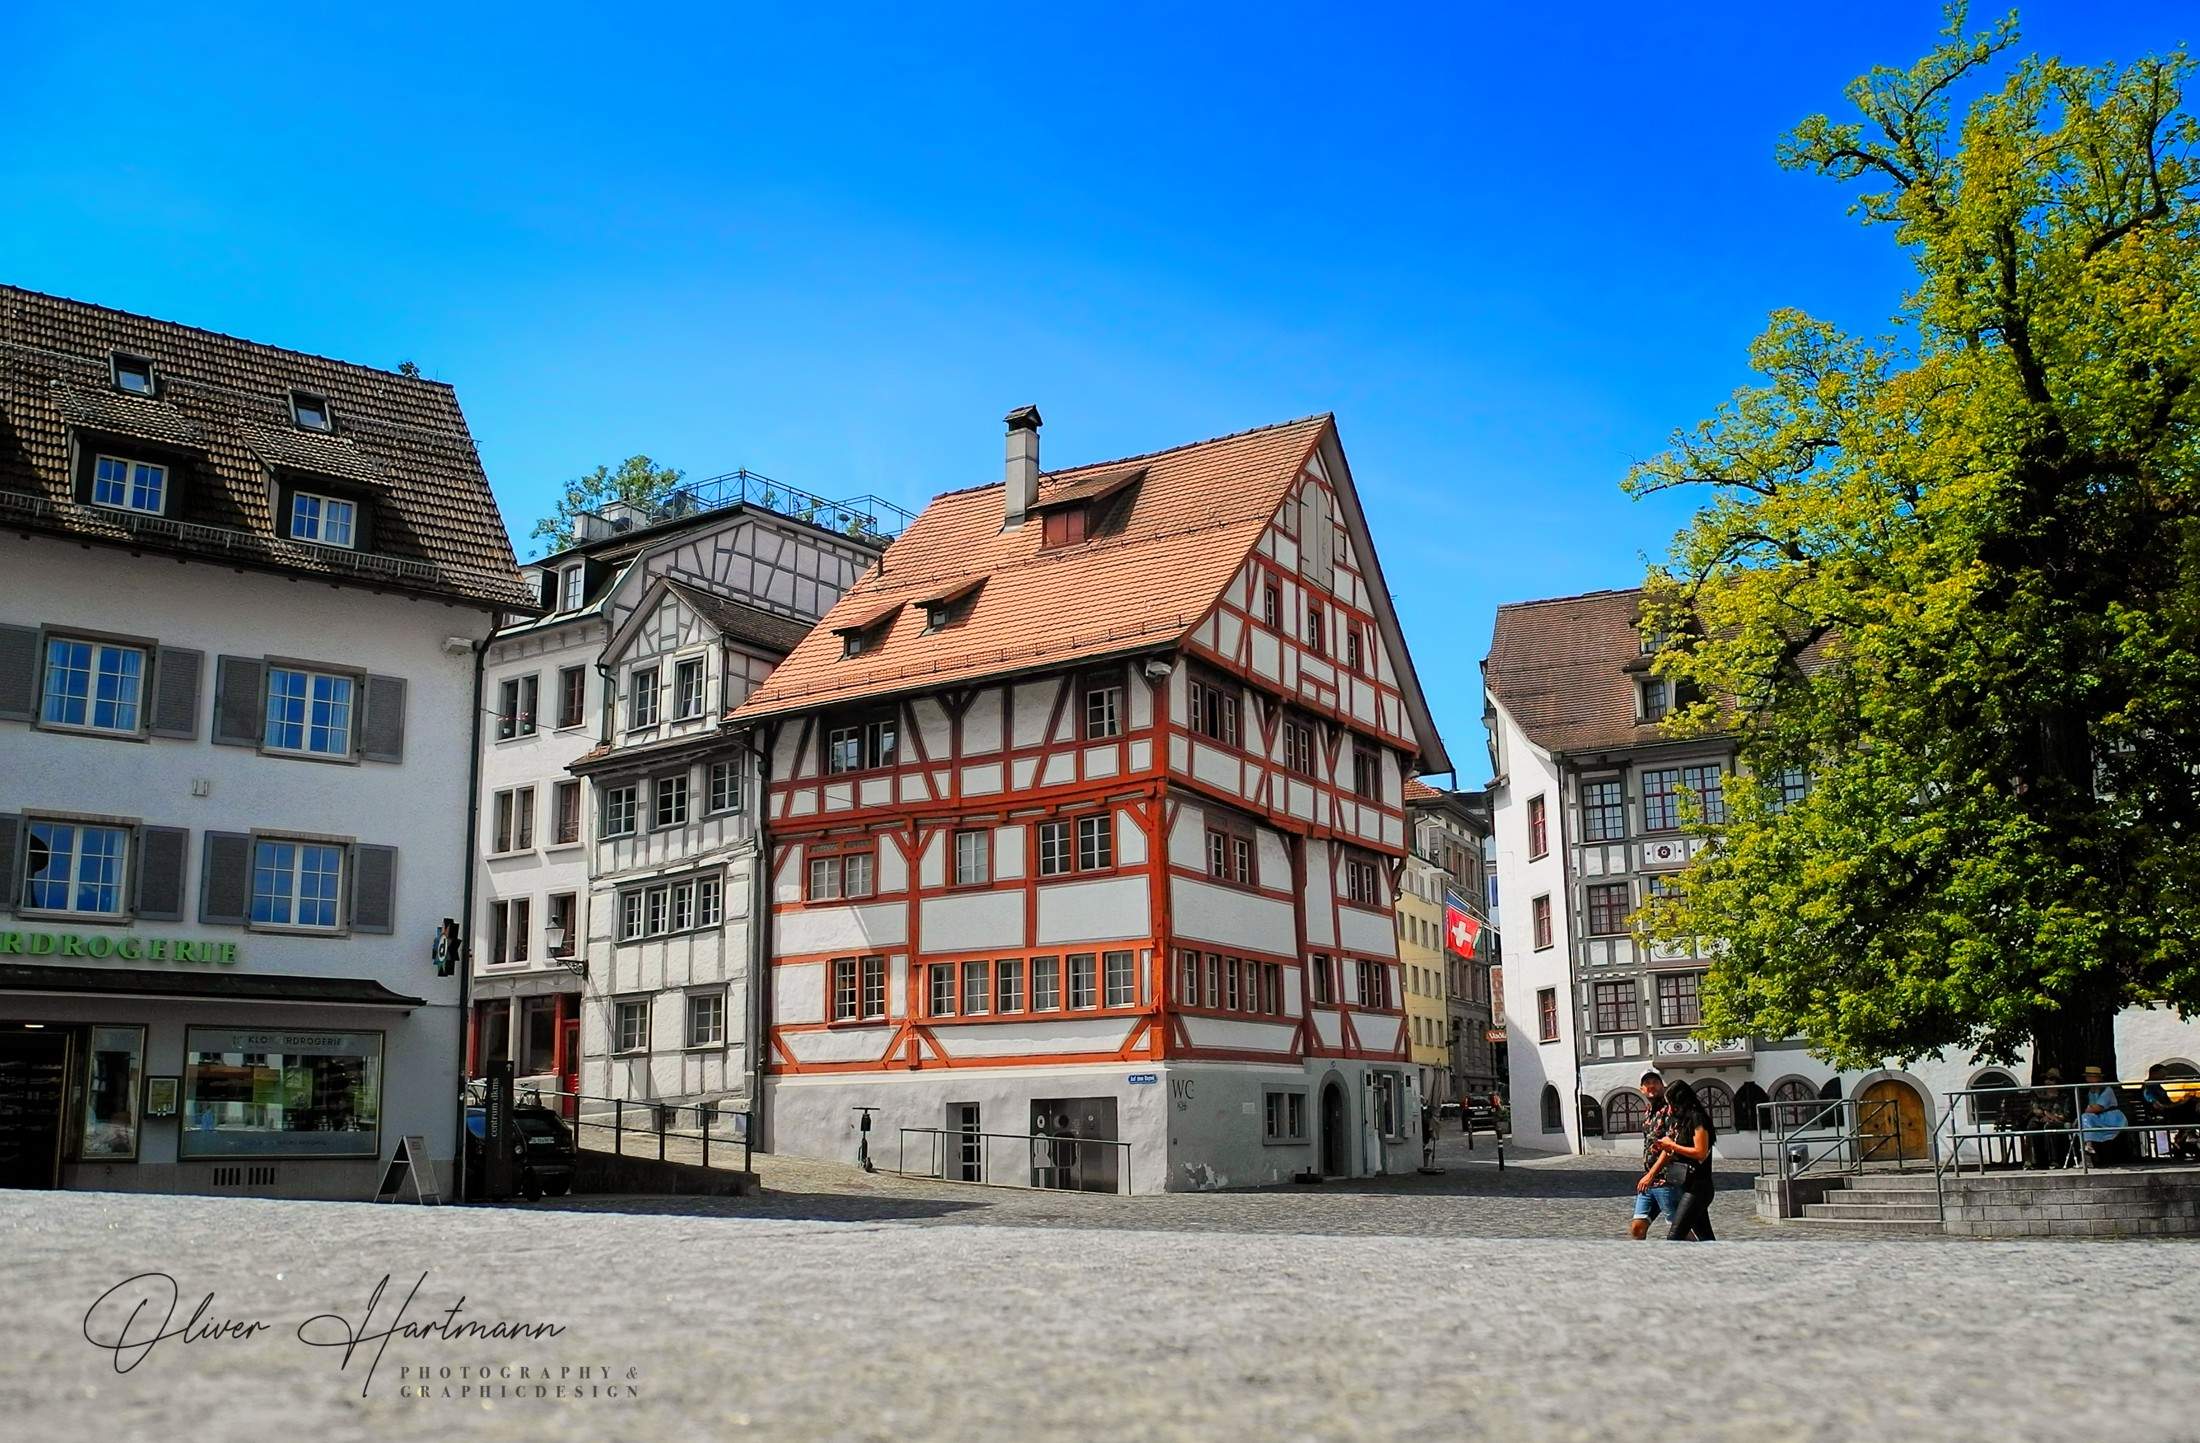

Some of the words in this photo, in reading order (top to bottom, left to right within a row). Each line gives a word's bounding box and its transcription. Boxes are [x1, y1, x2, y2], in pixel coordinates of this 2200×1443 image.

[0, 931, 238, 964] RDROGERIE
[1172, 1079, 1194, 1100] WC
[490, 1102, 498, 1137] centrum
